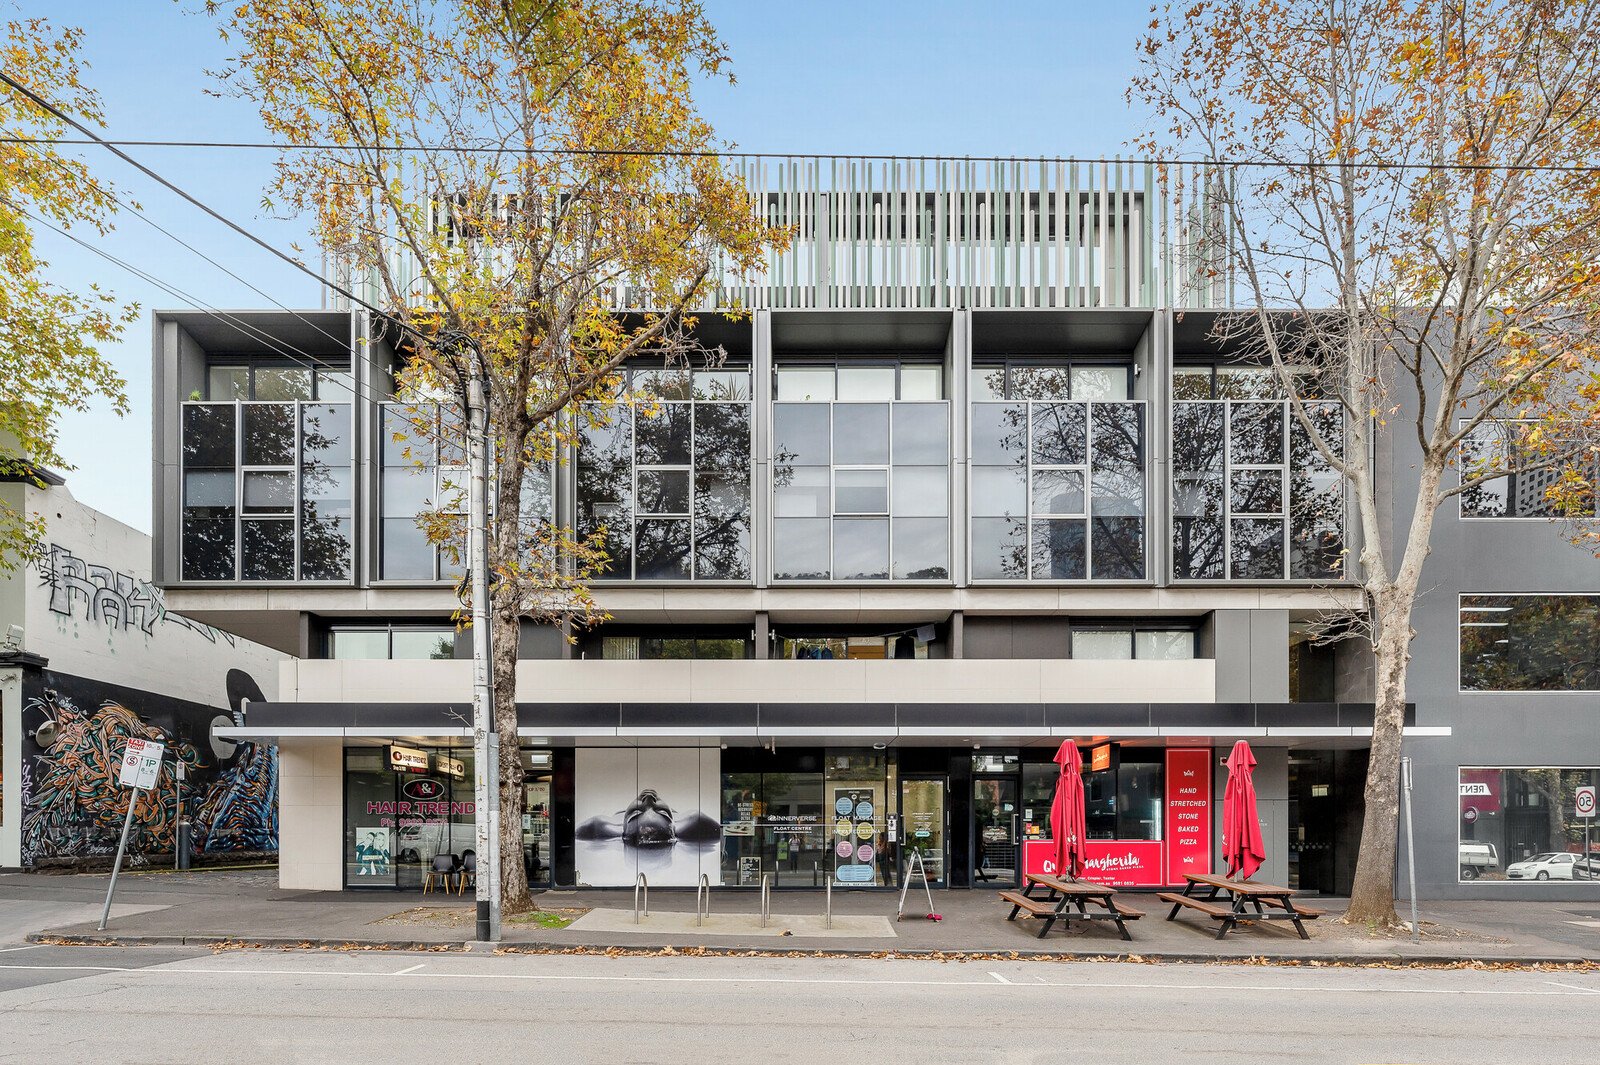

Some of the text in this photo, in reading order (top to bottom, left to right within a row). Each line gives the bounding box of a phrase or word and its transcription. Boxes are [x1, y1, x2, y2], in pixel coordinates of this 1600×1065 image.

[146, 759, 157, 767] 1P
[411, 782, 437, 796] A&J
[367, 801, 411, 815] HAIR
